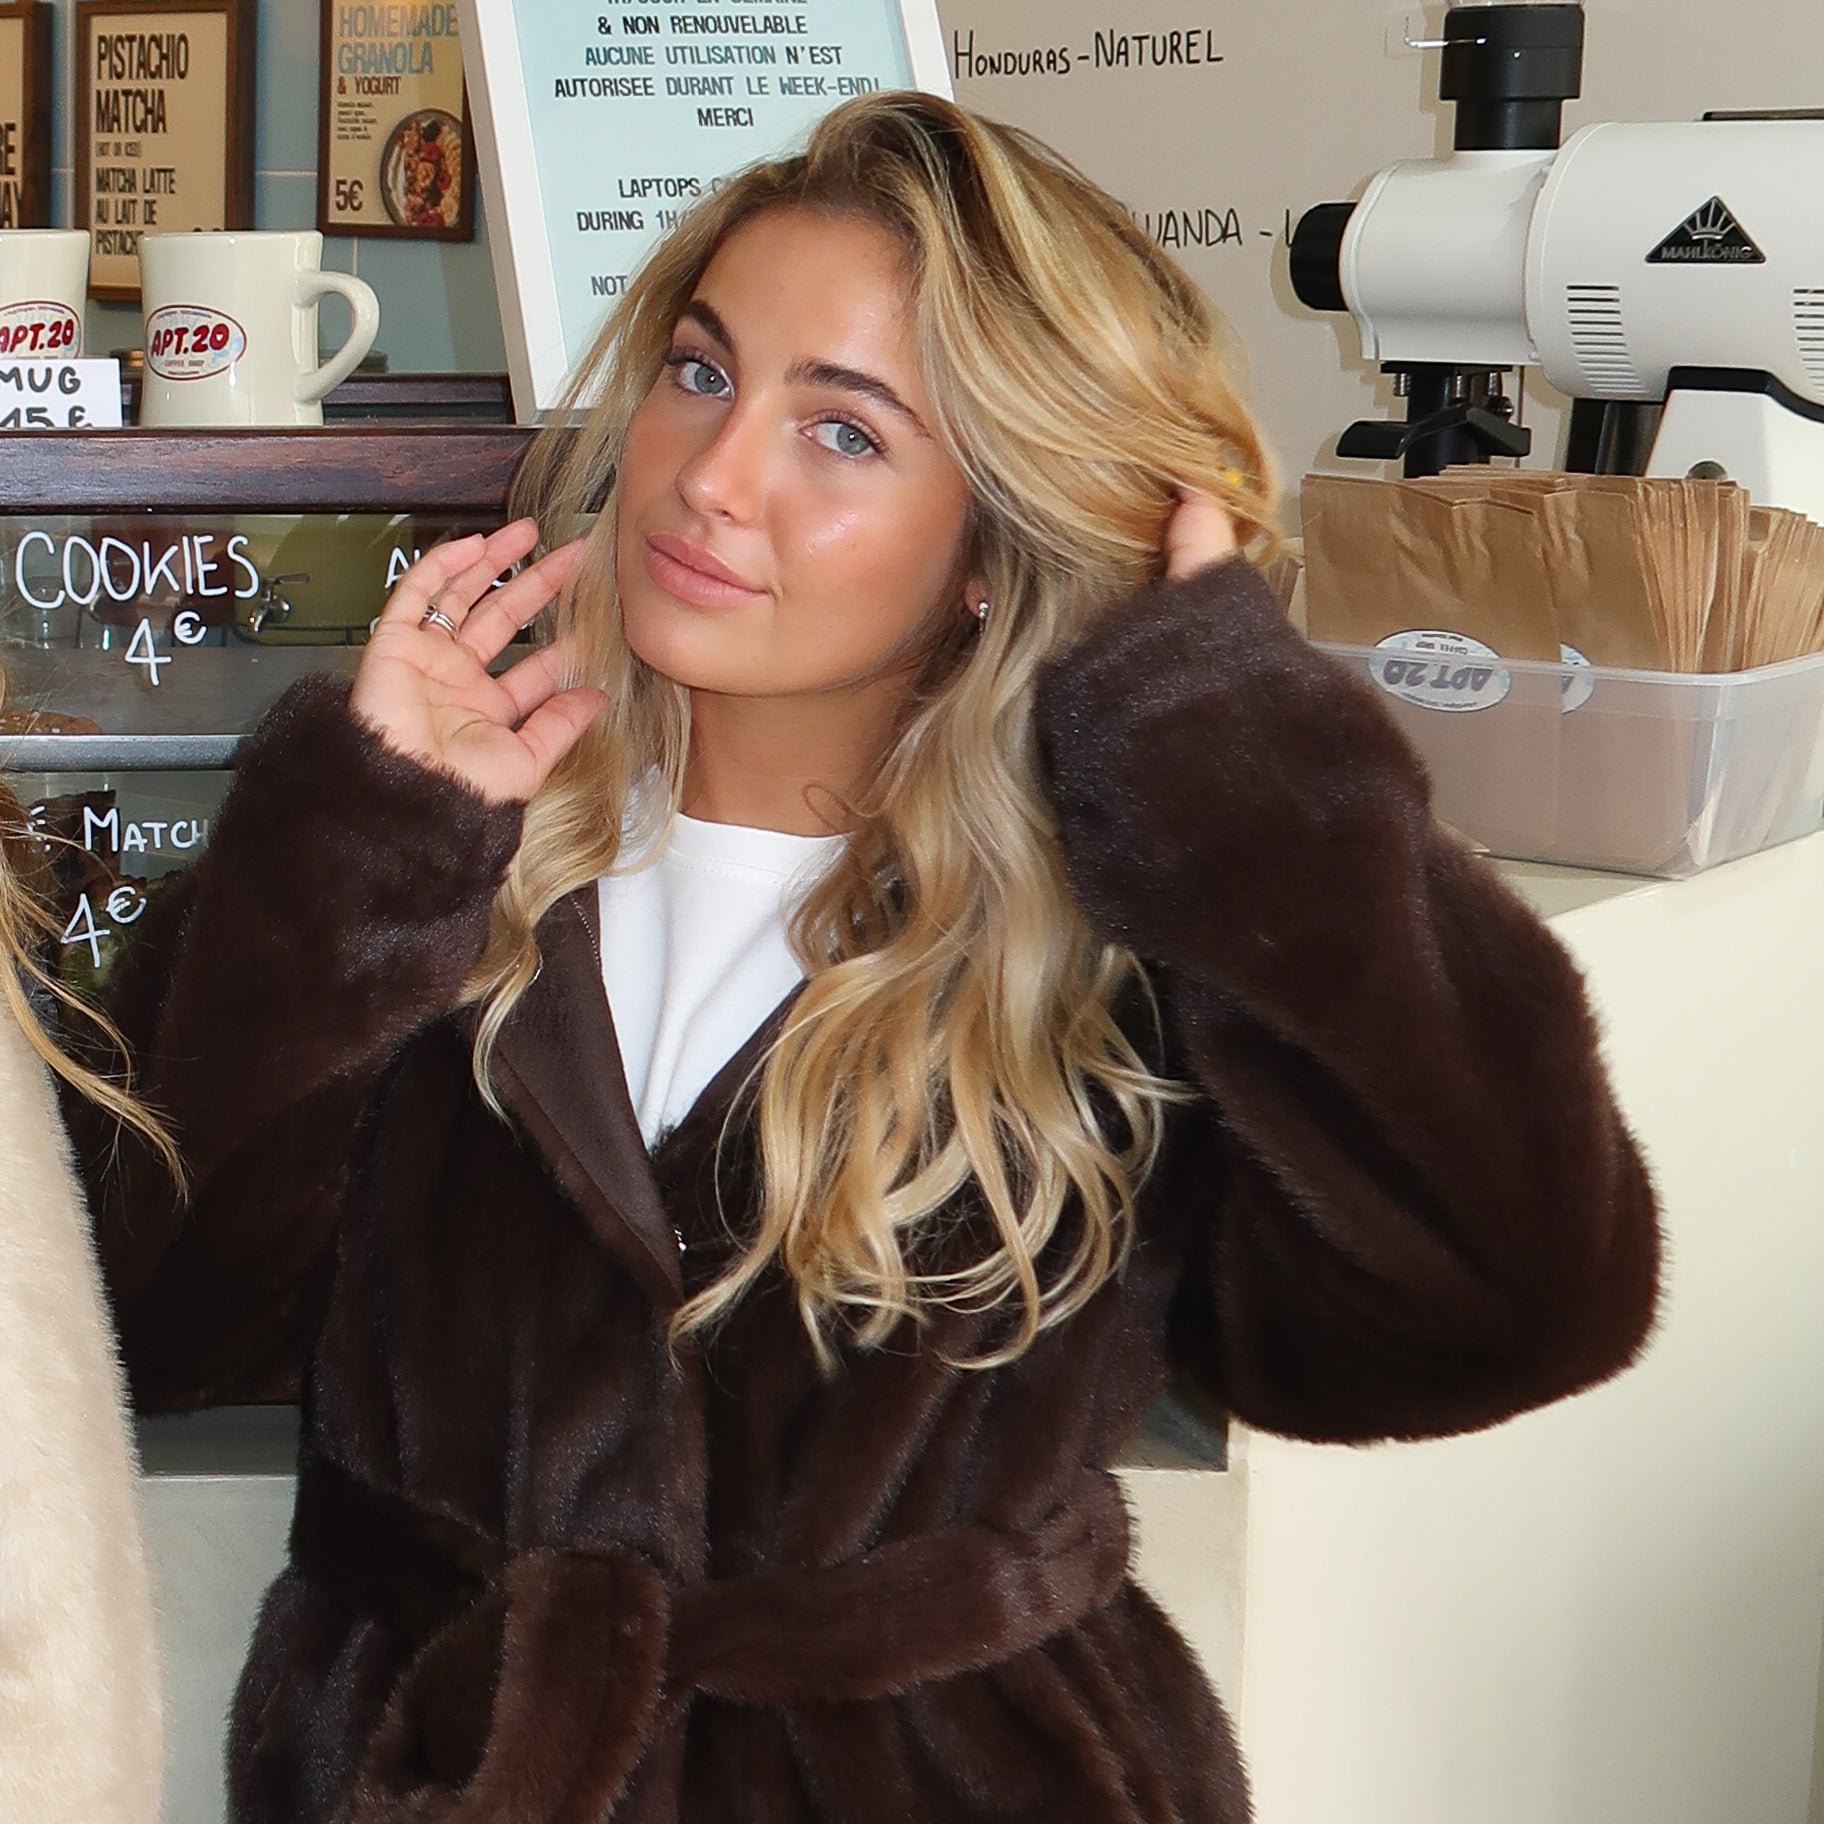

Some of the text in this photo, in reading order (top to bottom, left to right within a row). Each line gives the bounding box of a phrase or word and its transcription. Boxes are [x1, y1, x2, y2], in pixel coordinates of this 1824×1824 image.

[597, 16, 808, 35] & NON RENOUVELABLE
[97, 33, 190, 80] PISTACHIO
[337, 42, 434, 75] GRANOLA
[585, 46, 843, 66] AUCUNE UTILISATION N'EST
[337, 76, 402, 95] & YOGURT
[554, 77, 770, 98] AUTORISEE DURANT LE
[96, 87, 167, 134] MATCHA
[697, 108, 754, 127] MERCI
[96, 168, 176, 194] MATCHA LATTE
[617, 177, 702, 198] LAPTOPS
[335, 178, 364, 211] 5€
[95, 199, 157, 225] AU LAIT DE
[576, 210, 644, 231] DURING
[591, 275, 628, 296] NOT
[151, 324, 230, 357] APT.20
[15, 531, 260, 610] COOKIES
